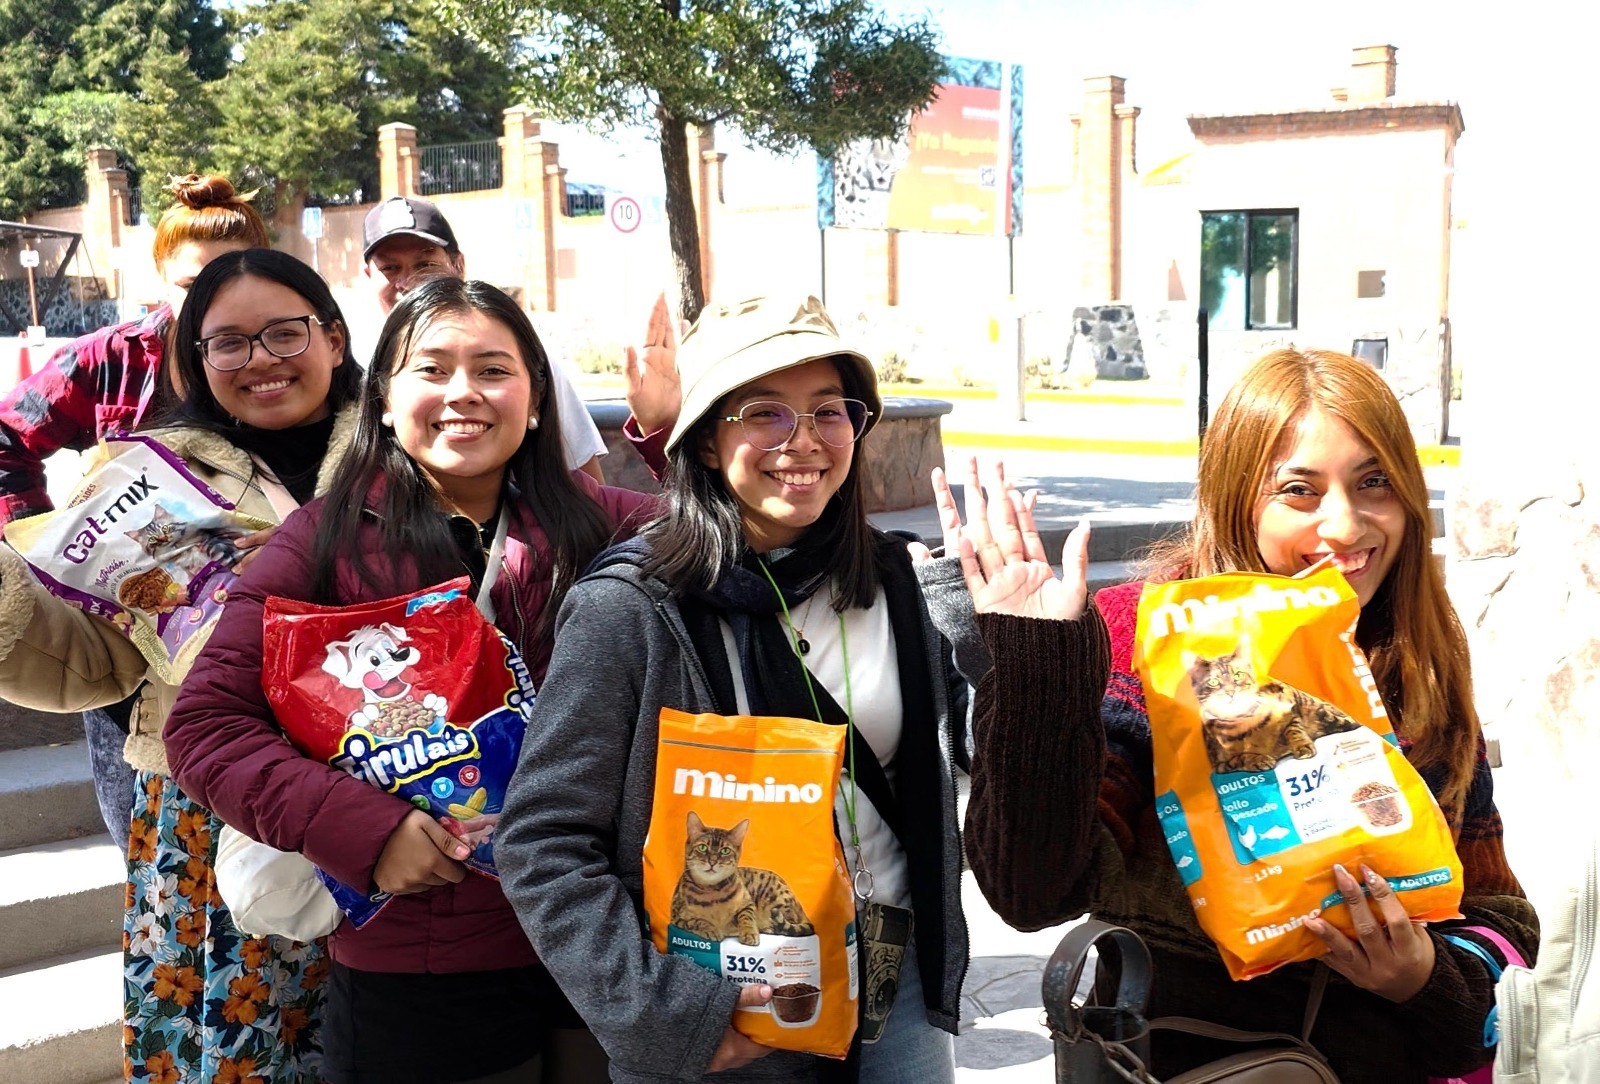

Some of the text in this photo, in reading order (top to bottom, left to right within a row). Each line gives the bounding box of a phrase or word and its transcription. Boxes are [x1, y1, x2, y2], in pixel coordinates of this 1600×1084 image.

[619, 204, 633, 220] 10
[63, 473, 160, 564] Cat-mix
[1150, 584, 1340, 637] minino
[673, 768, 823, 804] minino
[1286, 765, 1330, 796] 31%
[1167, 830, 1188, 844] cado
[1400, 871, 1449, 888] ADULTOS
[672, 936, 712, 950] ADULTOS
[726, 954, 766, 974] 31%
